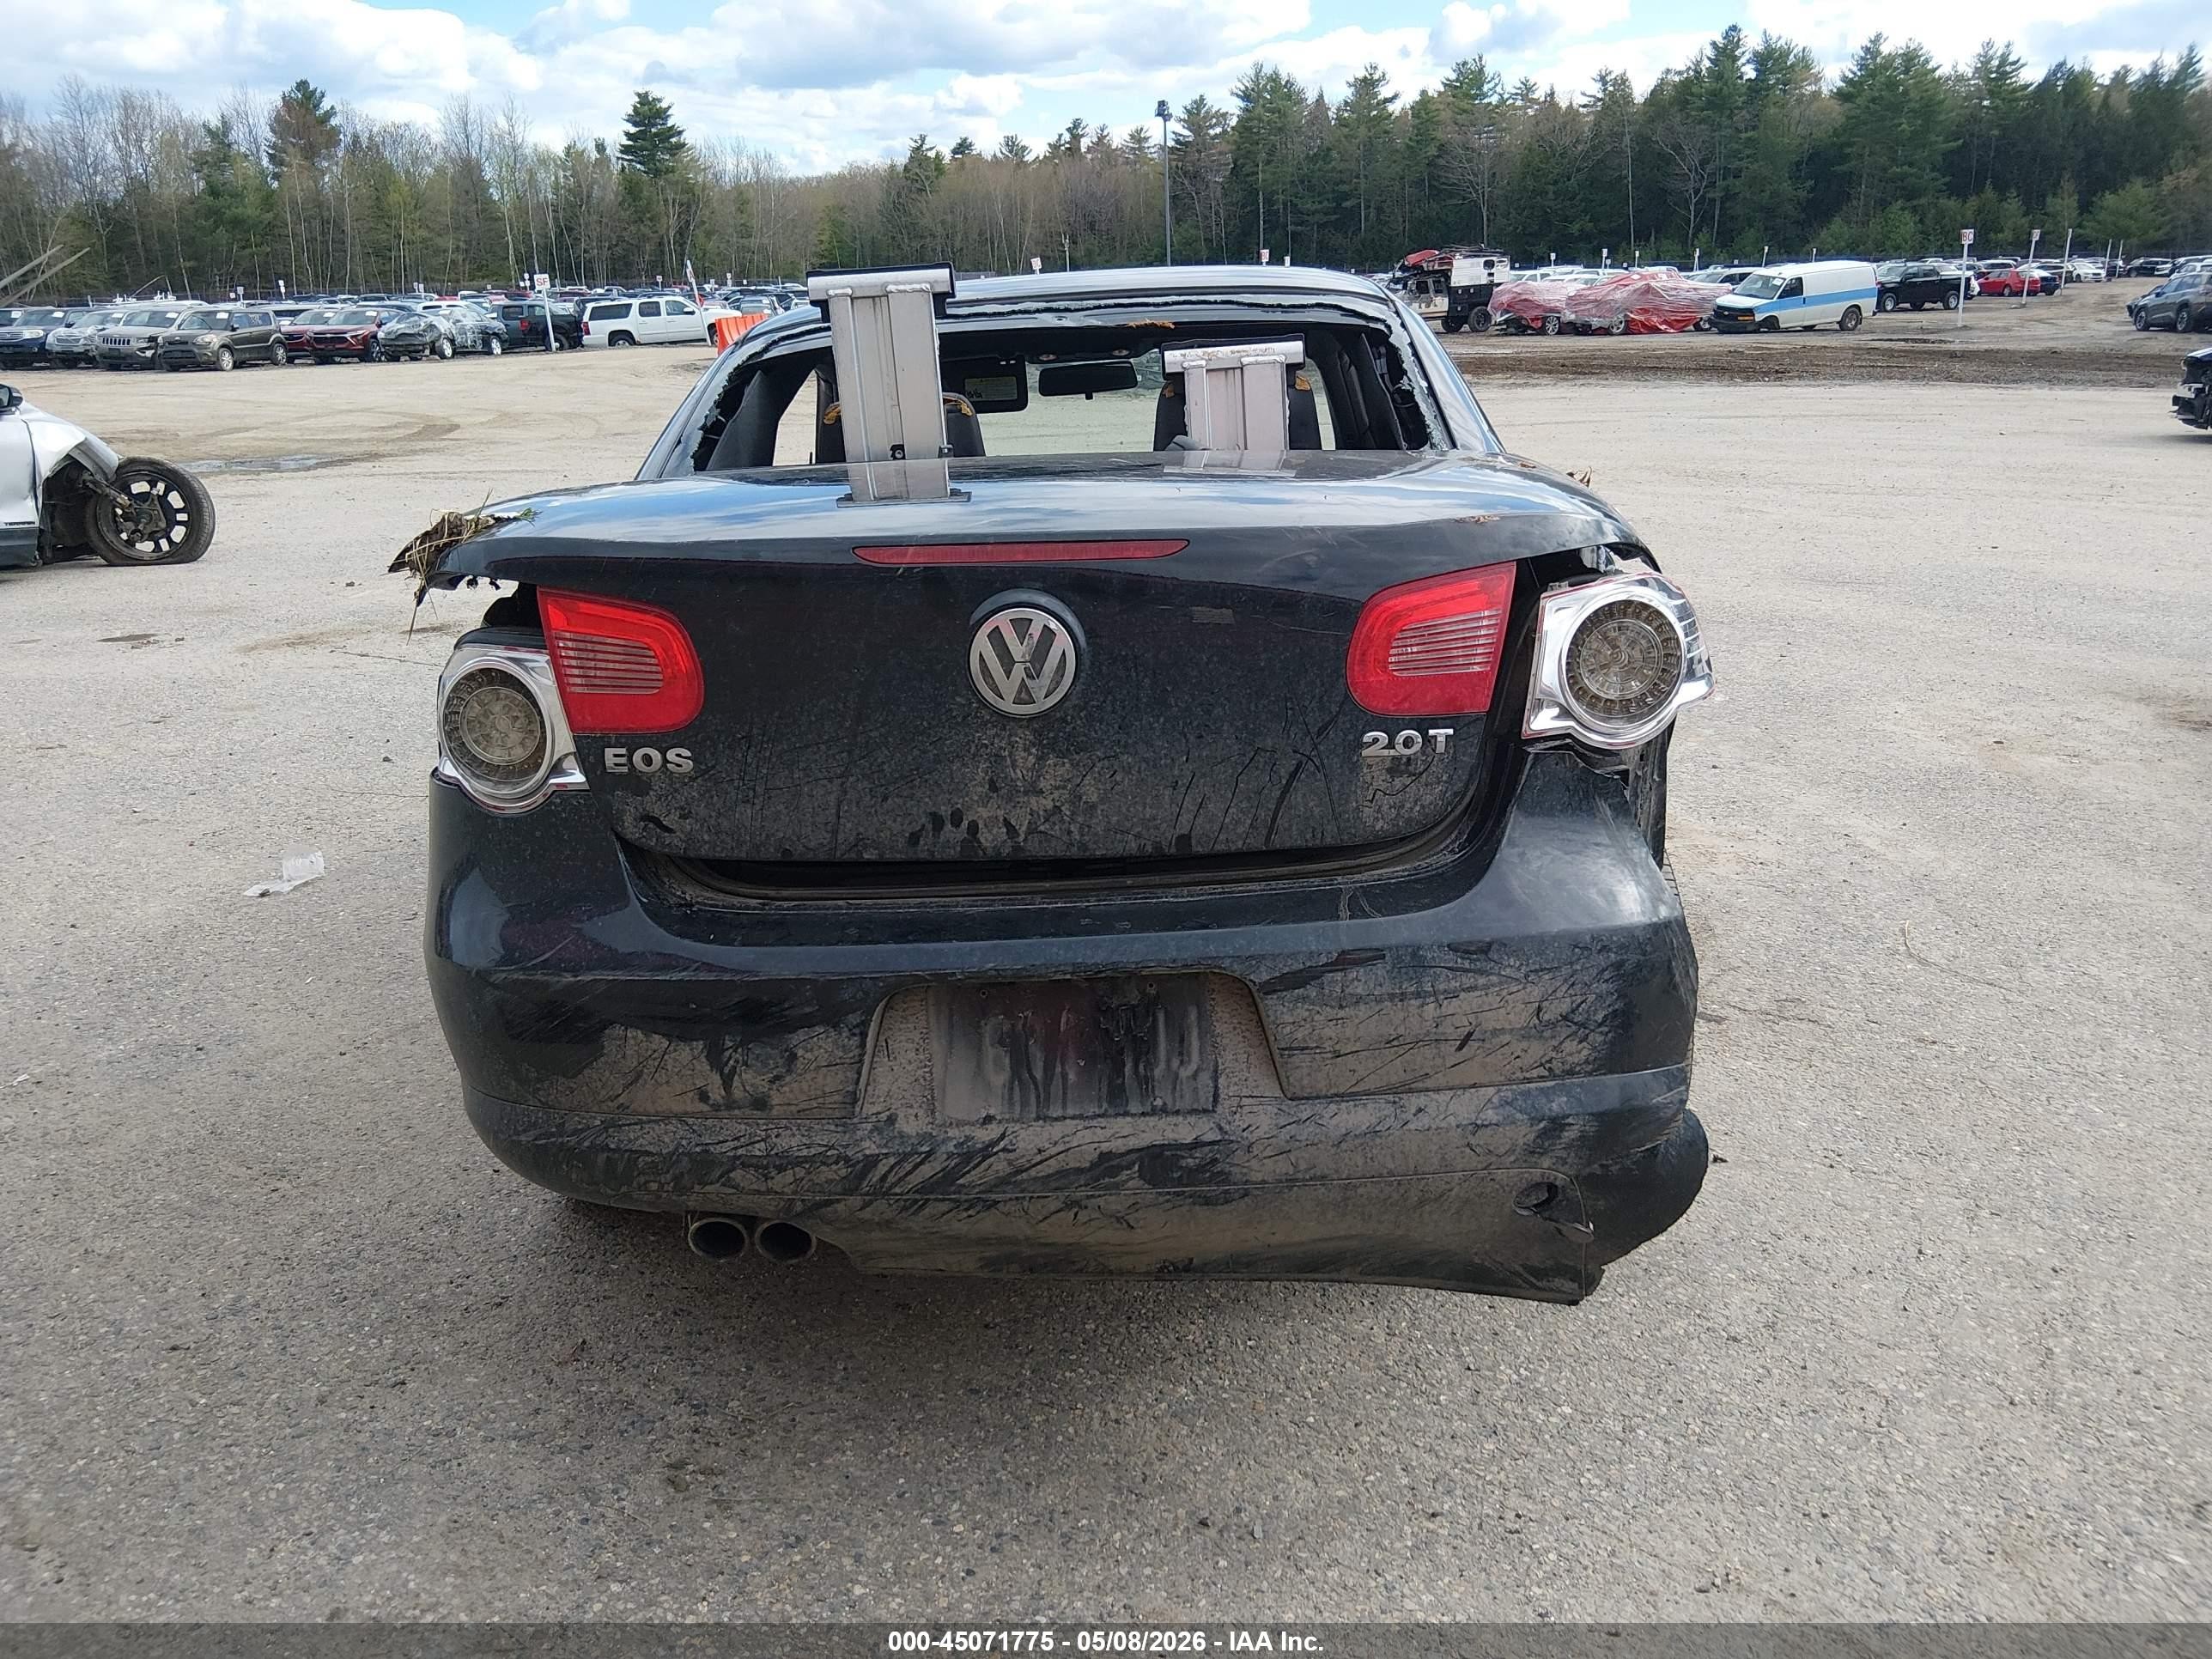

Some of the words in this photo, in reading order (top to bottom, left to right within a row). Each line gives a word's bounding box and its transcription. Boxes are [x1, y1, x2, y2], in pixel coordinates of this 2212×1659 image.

[1962, 231, 1973, 241] BC
[536, 277, 548, 287] SF
[604, 747, 694, 773] EOS
